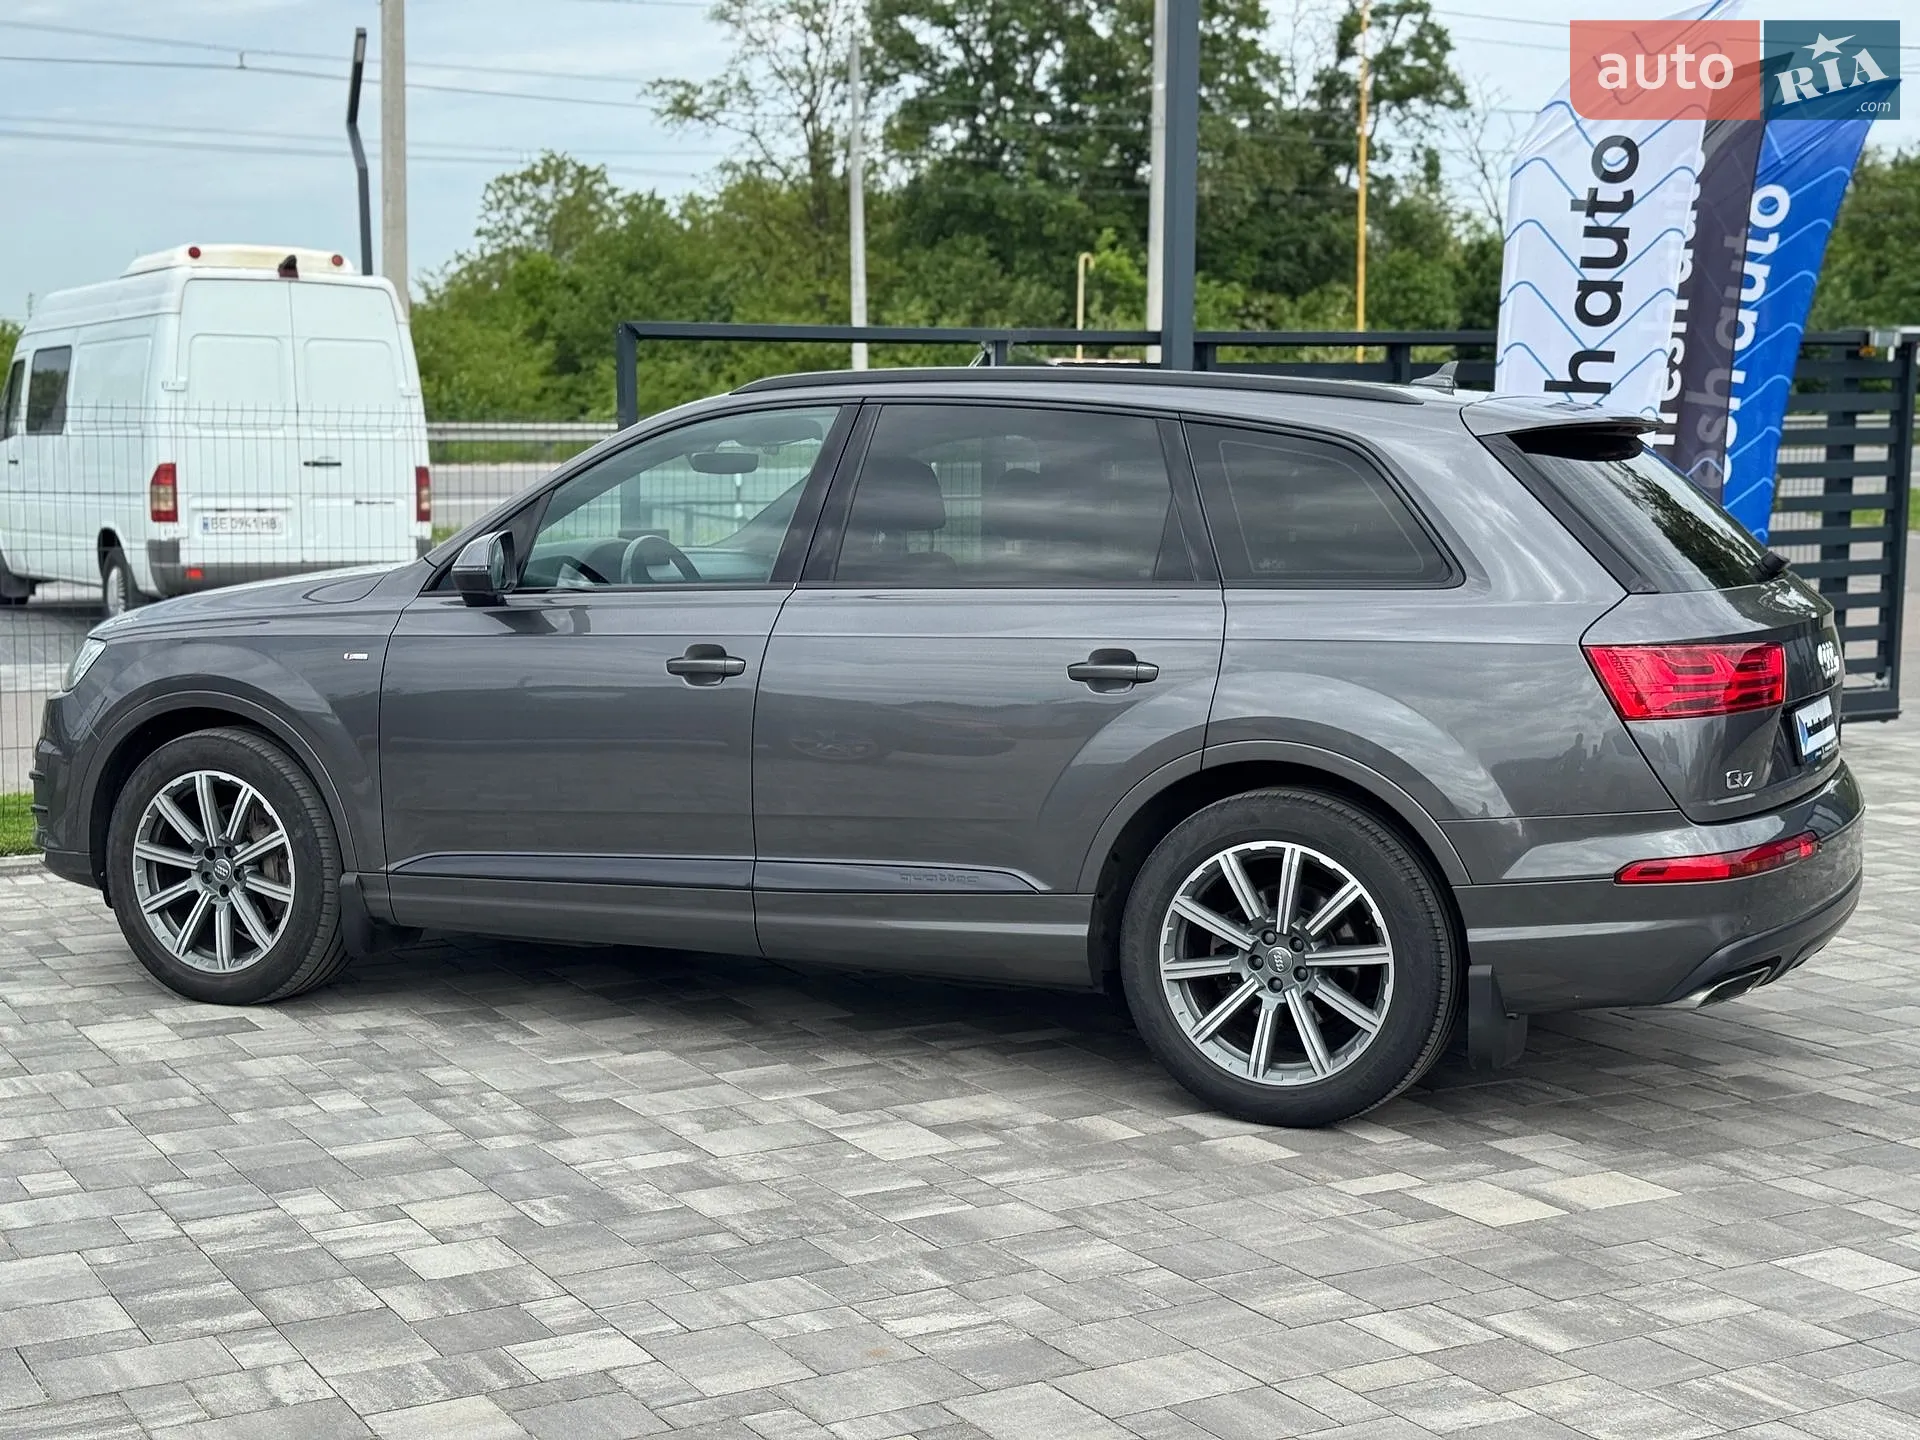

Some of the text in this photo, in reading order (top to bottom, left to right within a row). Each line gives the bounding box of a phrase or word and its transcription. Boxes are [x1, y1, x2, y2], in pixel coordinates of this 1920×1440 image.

[1570, 135, 1640, 328] auto
[1716, 184, 1791, 351] auto
[1726, 769, 1754, 790] Q7
